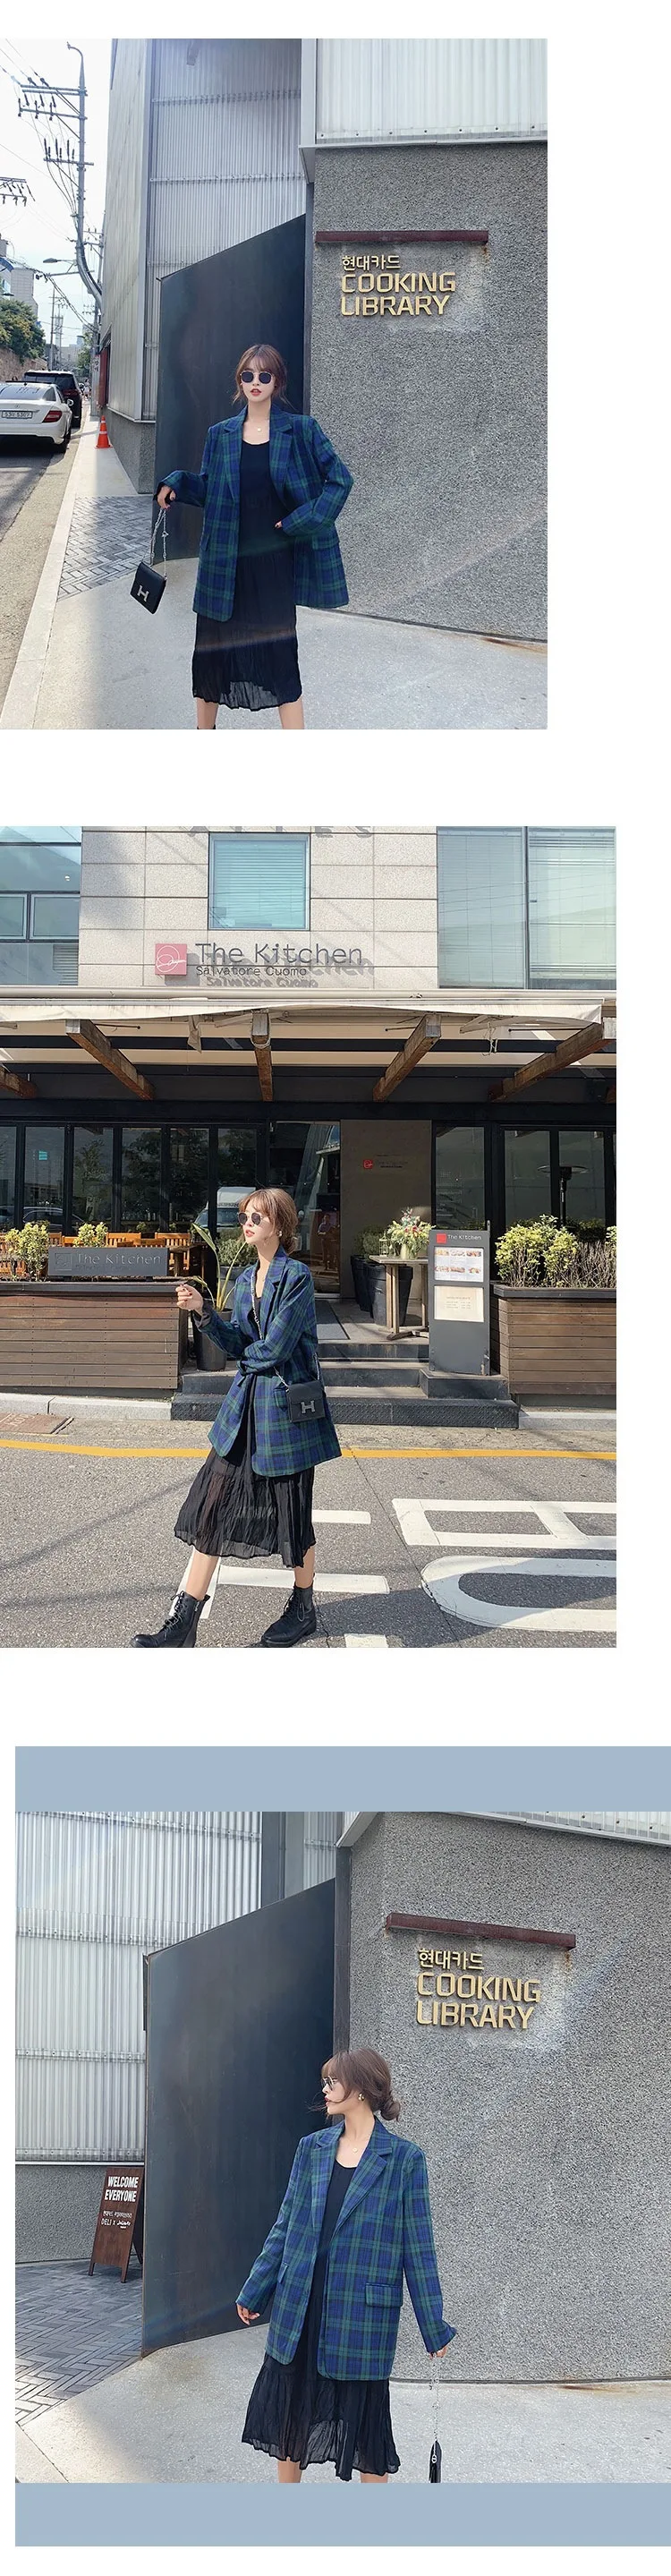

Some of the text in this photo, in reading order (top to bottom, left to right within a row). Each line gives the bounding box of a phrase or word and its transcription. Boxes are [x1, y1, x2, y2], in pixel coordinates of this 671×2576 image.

[342, 255, 401, 271] 현대카드
[341, 272, 456, 294] COOKING
[341, 294, 450, 316] LIBRARY
[195, 943, 362, 964] The Kitchen
[196, 966, 307, 977] Salvatore Cuomo
[77, 1253, 161, 1265] The Kitchen
[419, 1948, 484, 1971] 현대카드
[417, 1972, 541, 2003] COOKING
[416, 2000, 535, 2030] LIBRARY
[108, 2176, 139, 2188] WELCOME
[105, 2189, 137, 2202] EVERYONE
